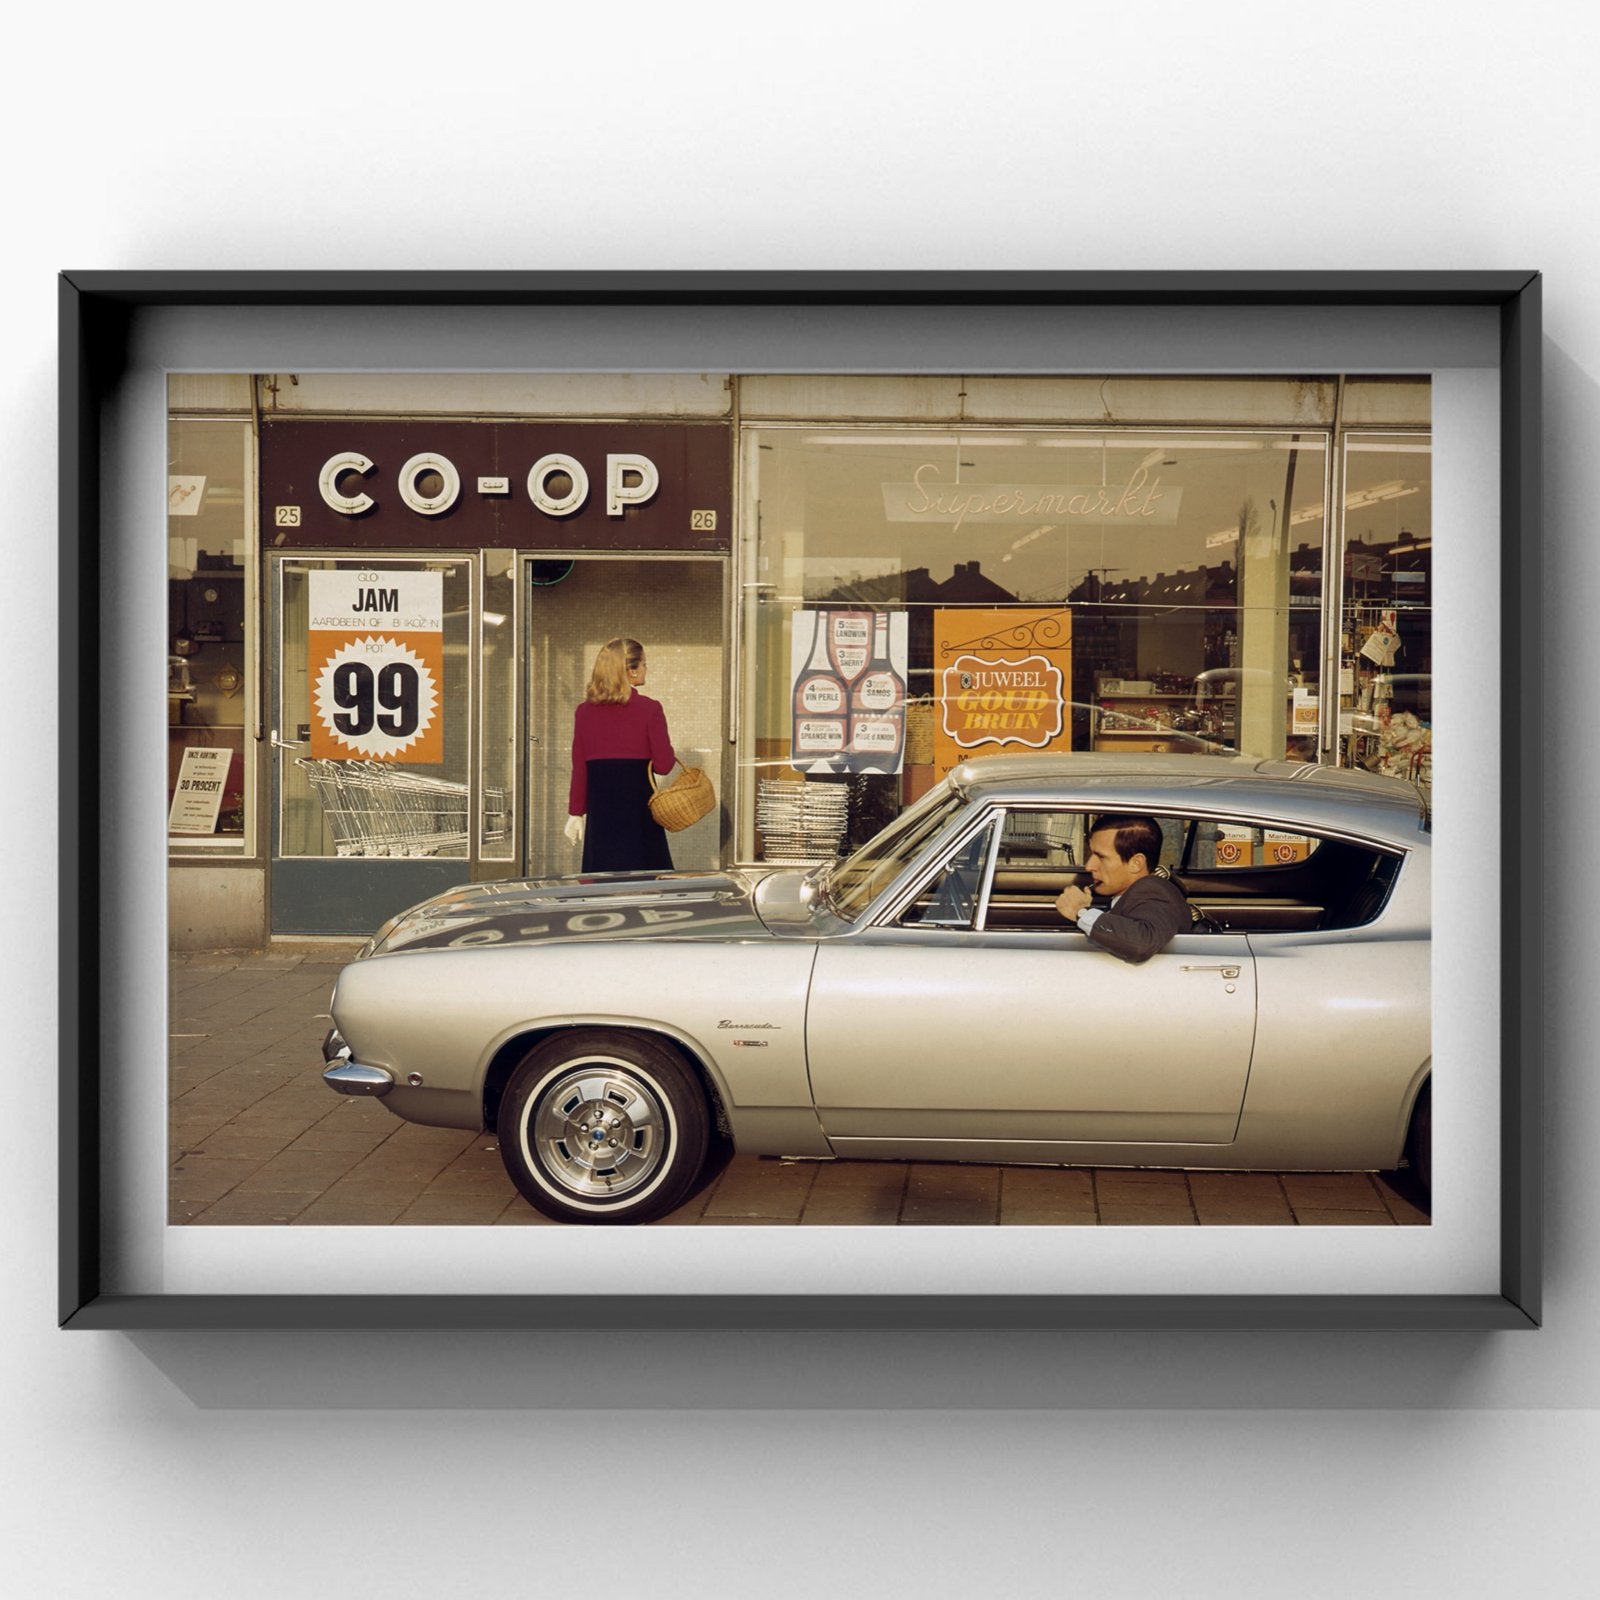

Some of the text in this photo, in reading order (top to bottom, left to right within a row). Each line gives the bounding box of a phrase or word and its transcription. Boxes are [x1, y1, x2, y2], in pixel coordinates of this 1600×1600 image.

[319, 452, 659, 516] CO-OP
[906, 464, 1164, 533] Supermarkt
[279, 508, 299, 524] 25
[693, 512, 714, 529] 26
[352, 588, 399, 612] JAM
[311, 617, 366, 627] AARDBEEN
[369, 618, 382, 628] OF
[838, 621, 845, 629] 5
[365, 644, 384, 654] POT
[838, 650, 845, 658] 3
[866, 680, 873, 688] 3
[972, 671, 1047, 690] JUWEEL
[808, 684, 816, 692] 4
[866, 689, 891, 697] SAMOS
[333, 661, 419, 738] 99
[805, 693, 839, 702] VIN PERLE
[957, 690, 1049, 711] GOUD
[962, 712, 1043, 730] BRUIN
[861, 724, 867, 732] 3
[180, 780, 190, 790] 30
